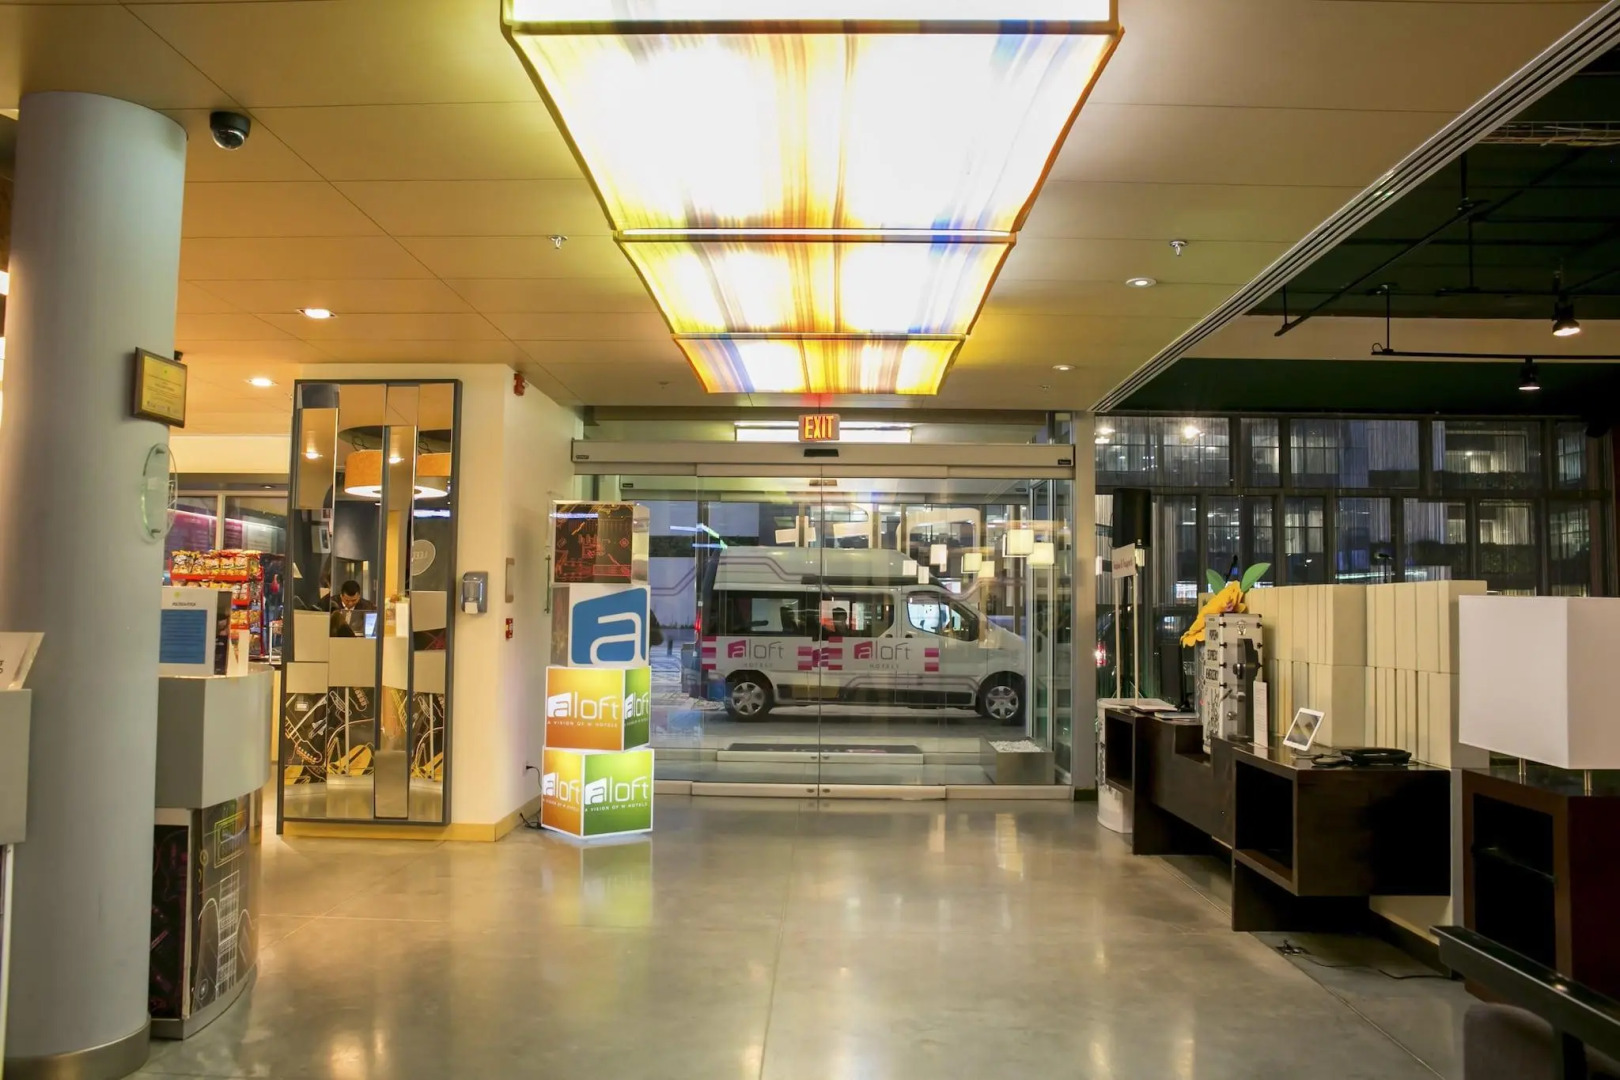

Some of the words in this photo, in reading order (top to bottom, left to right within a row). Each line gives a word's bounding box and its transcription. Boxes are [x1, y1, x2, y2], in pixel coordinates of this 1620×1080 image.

[804, 415, 834, 439] EXIT
[728, 639, 784, 659] aloft
[854, 640, 911, 660] aloft
[548, 691, 620, 720] aloft
[543, 772, 580, 805] aloft
[585, 776, 649, 806] aloft
